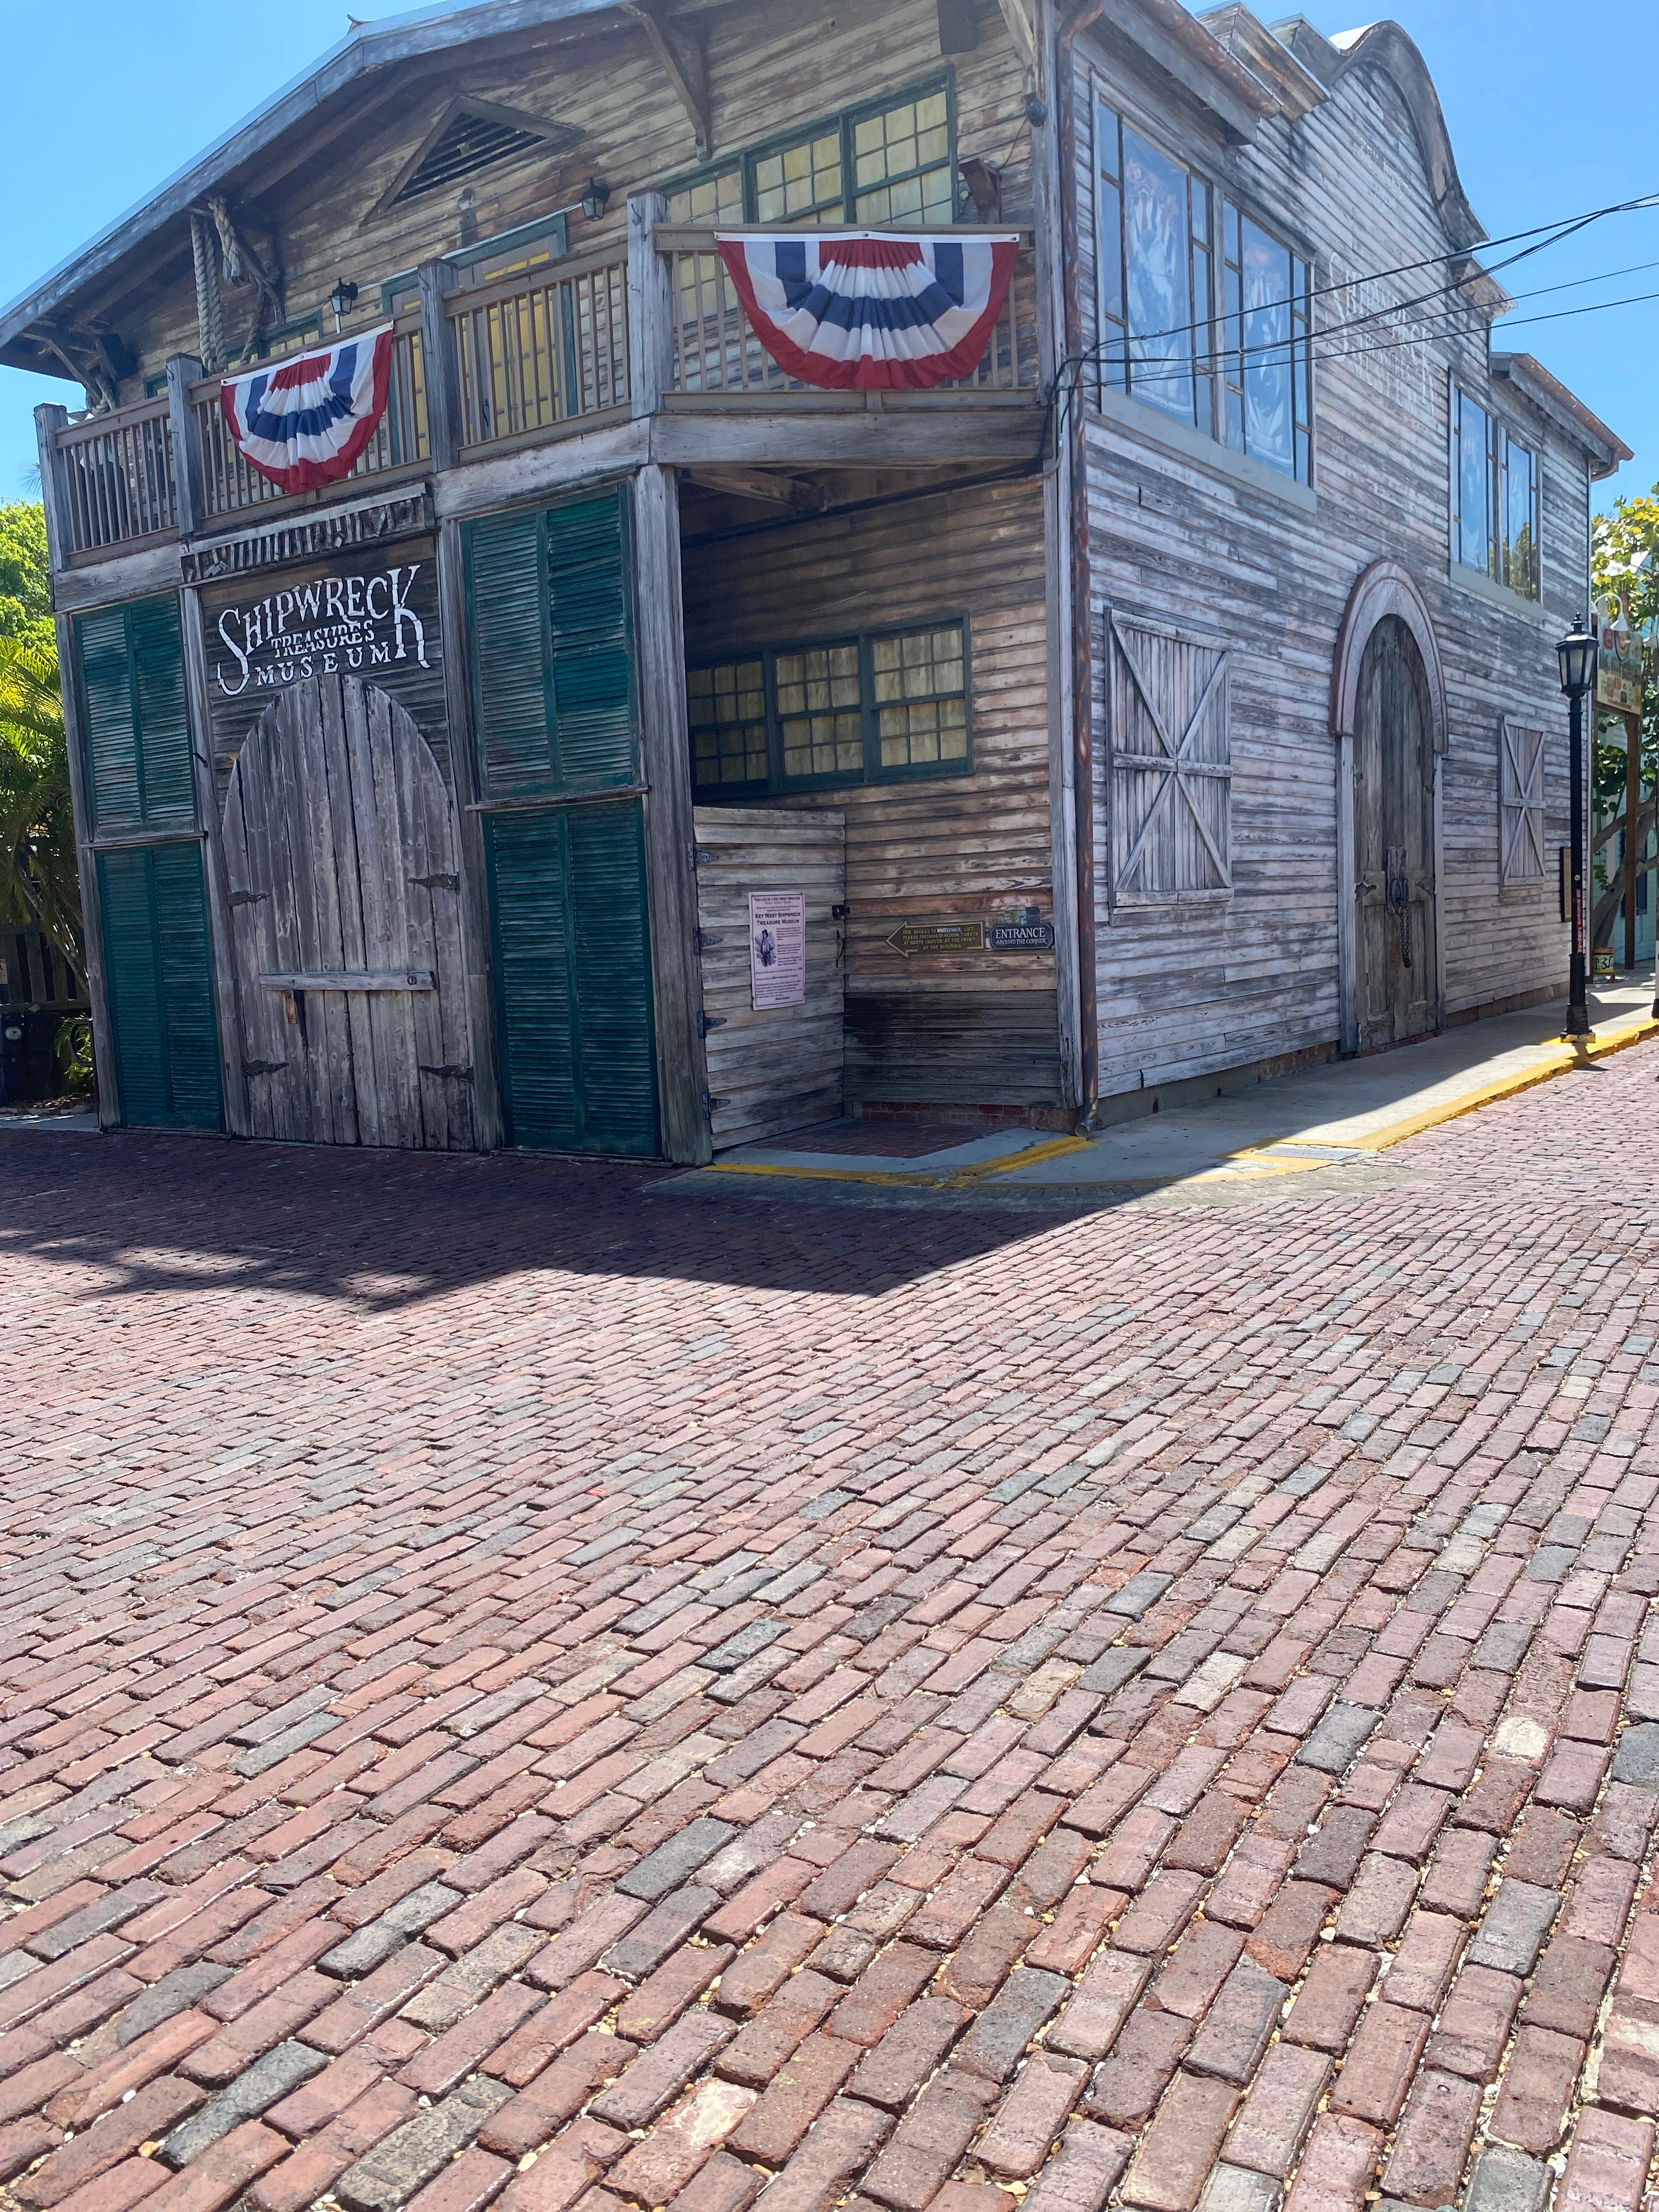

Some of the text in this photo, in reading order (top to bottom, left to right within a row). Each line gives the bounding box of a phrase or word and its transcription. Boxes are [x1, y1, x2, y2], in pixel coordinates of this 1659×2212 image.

[218, 565, 430, 696] SHIPWRECK
[271, 619, 375, 658] TREASURES
[255, 641, 392, 686] MUSEUM
[995, 927, 1046, 939] ENTRANCE
